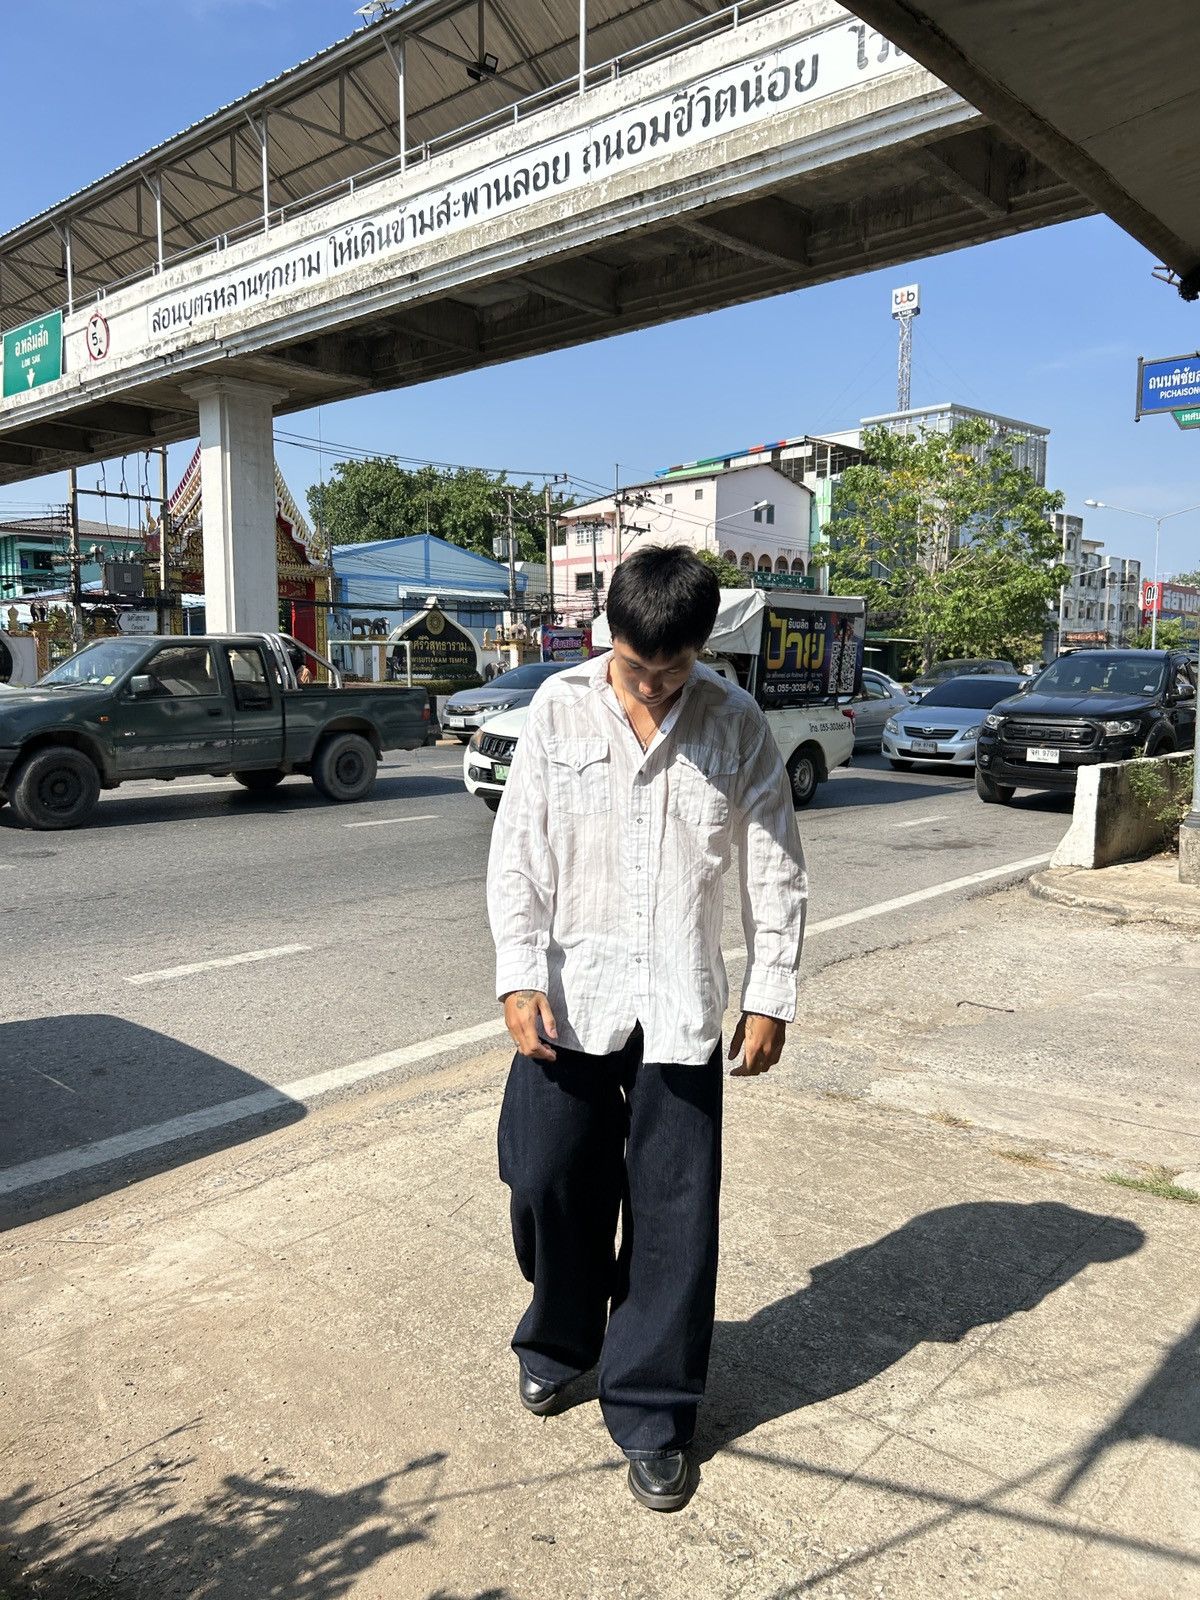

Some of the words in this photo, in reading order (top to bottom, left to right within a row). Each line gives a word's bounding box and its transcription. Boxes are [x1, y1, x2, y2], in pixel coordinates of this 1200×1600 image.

[152, 250, 321, 333] สอนบุตรหลานทุกยาม
[329, 152, 570, 268] ให้เดินข้ามสะพานลอย
[583, 53, 819, 174] ถนอมชีวิตน้อย
[895, 290, 916, 305] ttb
[15, 324, 49, 357] อ.หล่มสัก
